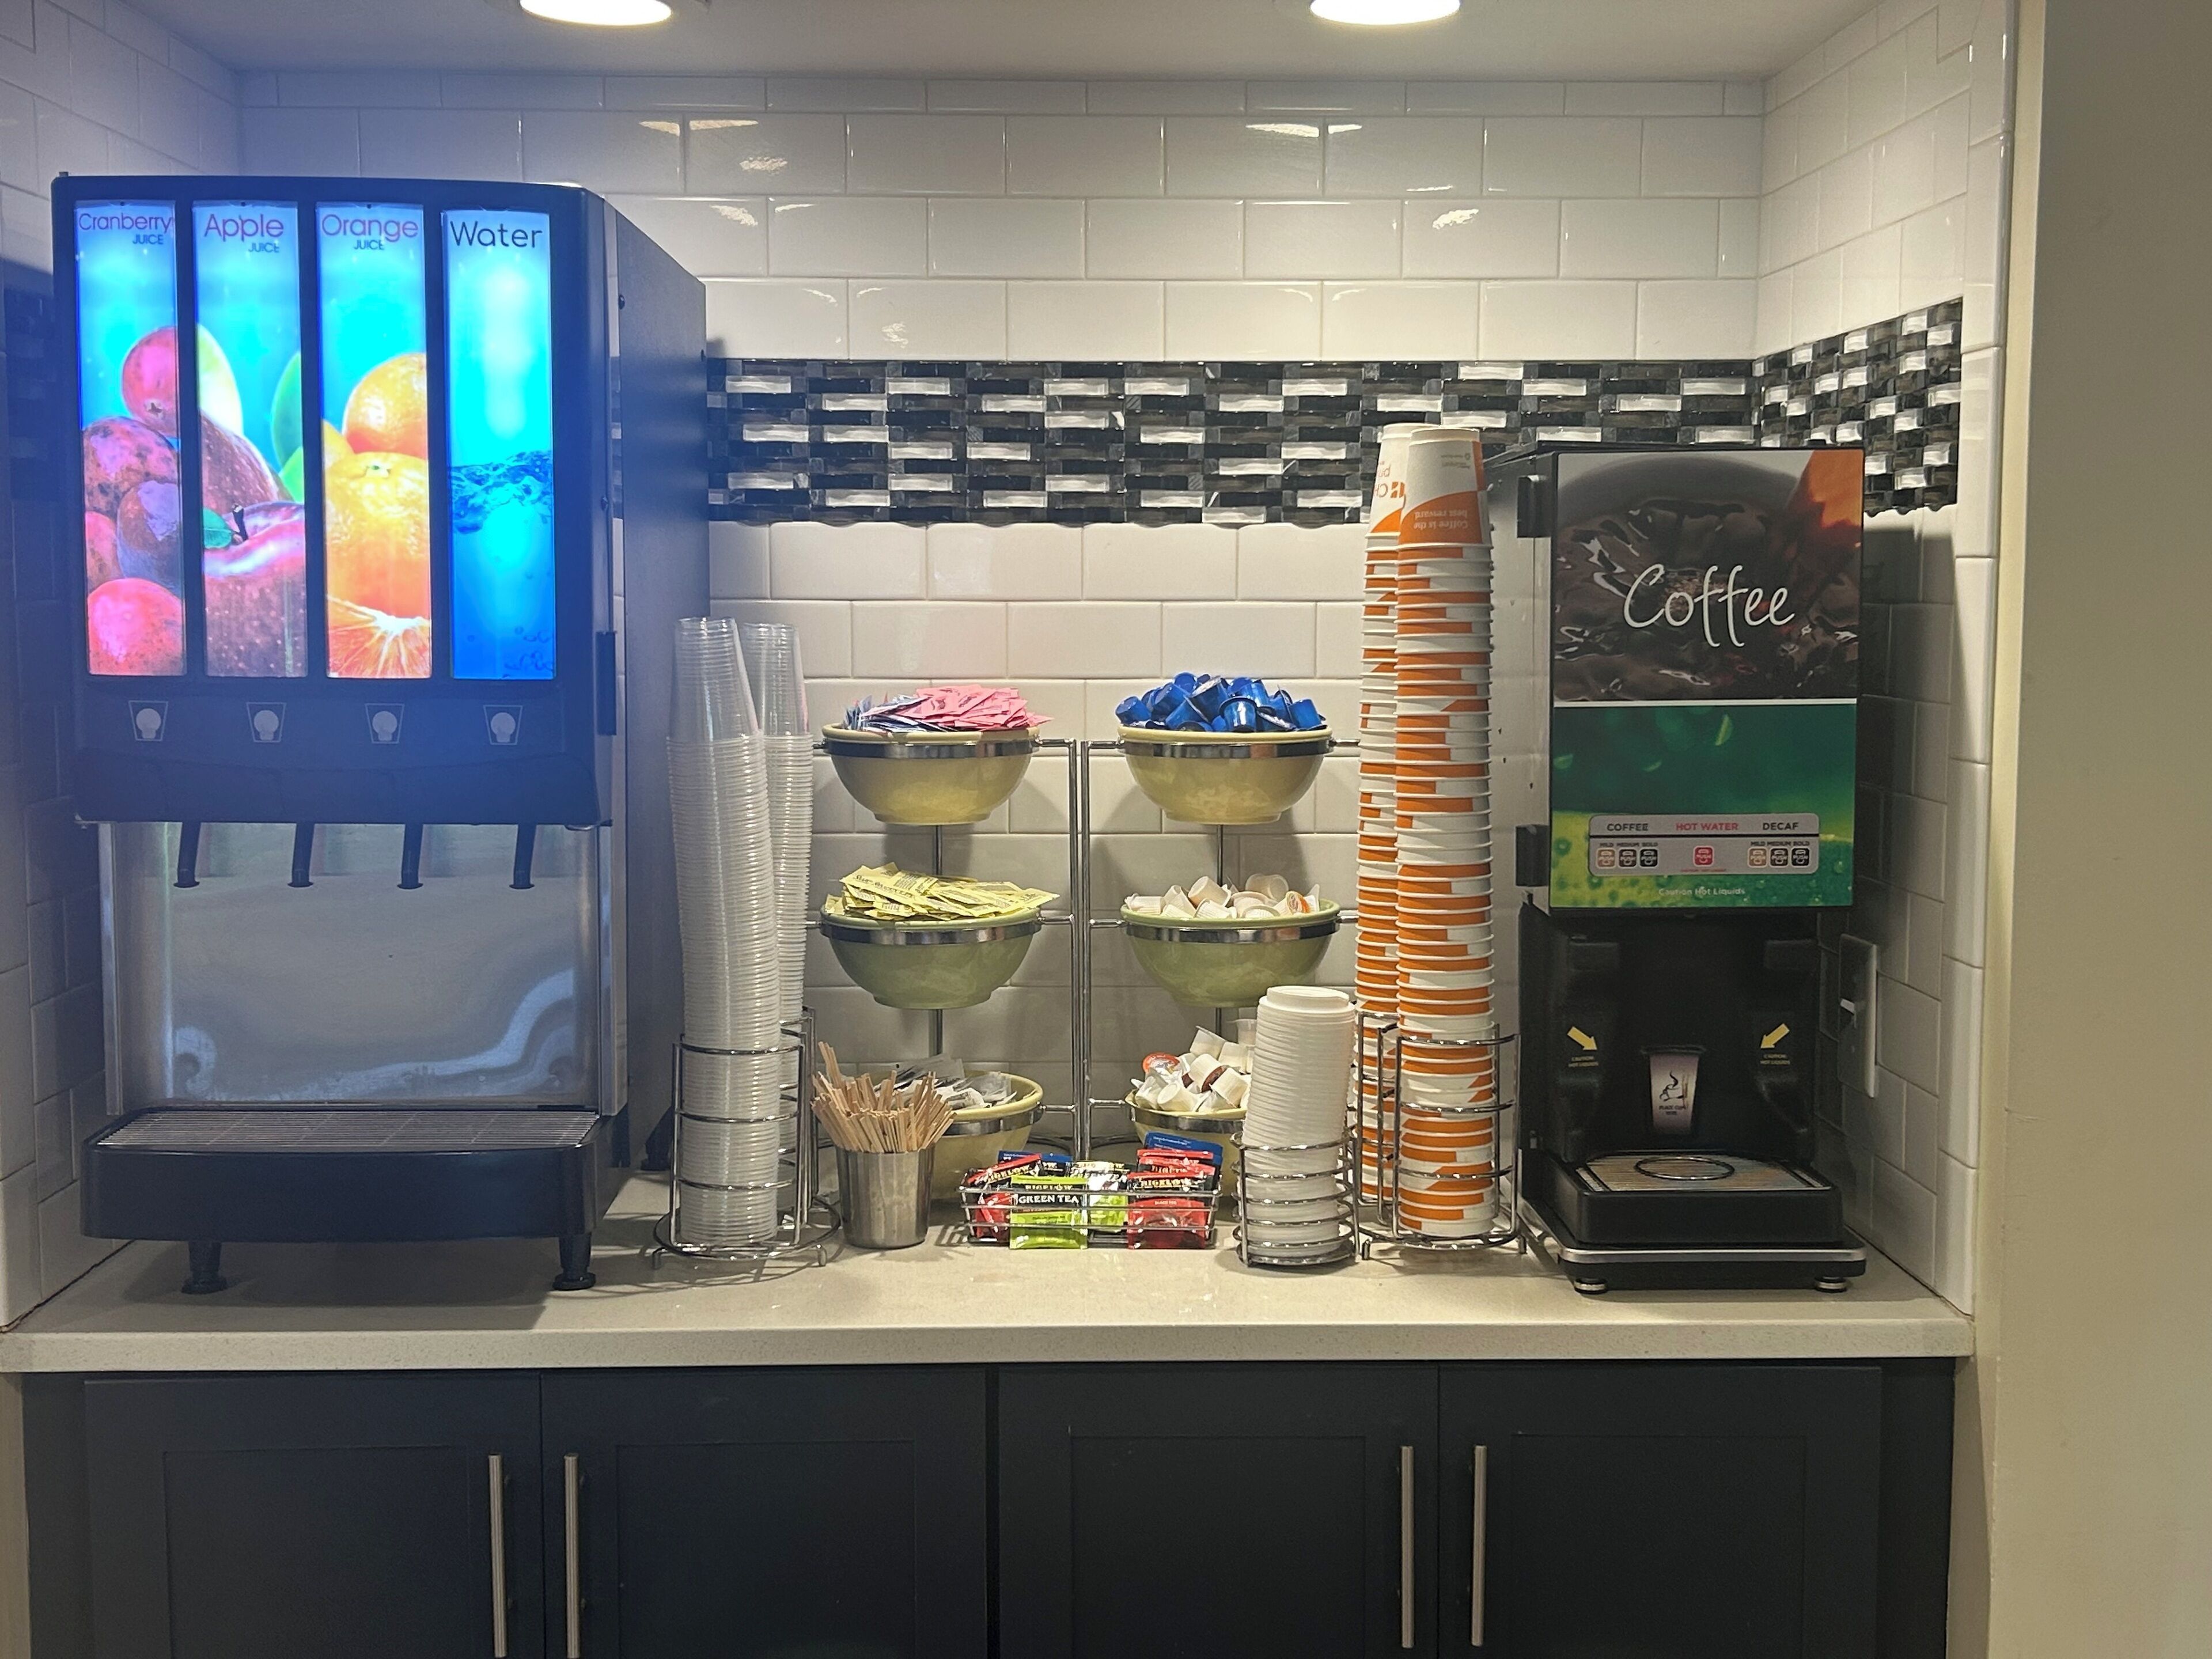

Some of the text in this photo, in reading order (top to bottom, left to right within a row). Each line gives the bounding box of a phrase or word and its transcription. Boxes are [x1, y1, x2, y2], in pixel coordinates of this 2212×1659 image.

[78, 213, 171, 234] Cranberry
[204, 214, 285, 241] Apple
[321, 214, 419, 243] Orange
[132, 234, 164, 245] JUICE
[450, 220, 543, 249] Water
[248, 242, 280, 253] JUICE
[353, 239, 385, 251] JUICE
[1413, 522, 1427, 530] the
[1439, 520, 1468, 529] Coffee
[1623, 563, 1795, 648] Coffee
[1607, 822, 1649, 832] COFFEE
[1676, 821, 1739, 832] HOT WATER
[1762, 821, 1799, 831] DECAF
[1658, 887, 1745, 897] Caution Hot Liquids
[1018, 1194, 1079, 1203] GREEN TEA
